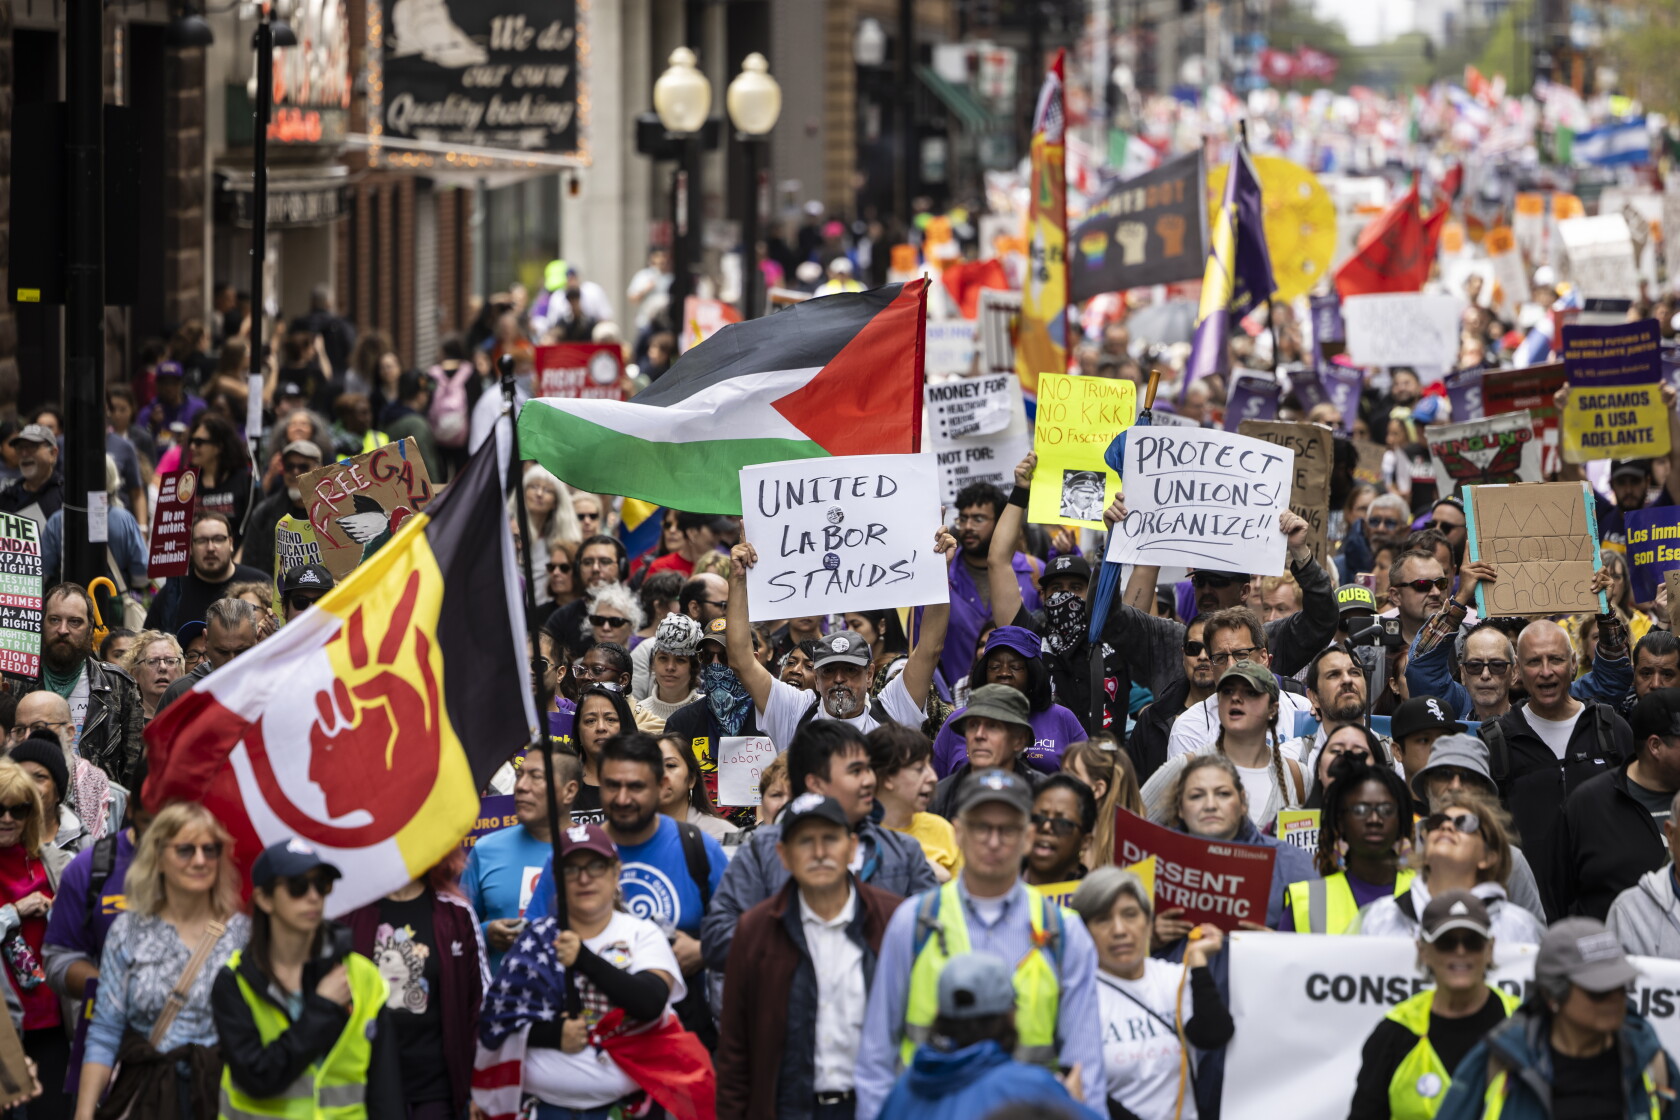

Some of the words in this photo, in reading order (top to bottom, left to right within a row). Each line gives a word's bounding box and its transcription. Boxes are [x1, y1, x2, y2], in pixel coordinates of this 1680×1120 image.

[489, 14, 535, 50] We
[537, 19, 575, 50] do
[461, 63, 511, 88] our
[512, 63, 570, 88] own
[387, 92, 486, 135] Quality
[485, 92, 575, 134] baking
[928, 382, 980, 403] MONEY
[1040, 377, 1072, 400] NO
[1079, 378, 1134, 401] TRUMP!
[1578, 390, 1650, 411] SACAMOS
[1038, 403, 1067, 423] NO
[1594, 412, 1604, 429] A
[1607, 411, 1637, 428] USA
[1036, 426, 1063, 445] NO
[1430, 427, 1532, 456] NINGUNO
[1581, 427, 1655, 448] ADELANTE
[937, 448, 962, 465] NOT
[965, 446, 995, 462] FOR:
[1134, 436, 1284, 474] PROTECT
[369, 449, 431, 512] GAZ
[758, 474, 898, 518] UNITED
[1153, 477, 1282, 510] UNIONS!
[162, 511, 173, 522] We
[173, 510, 186, 521] are
[1494, 497, 1576, 539] MY
[158, 521, 186, 535] workers,
[1122, 509, 1273, 544] ORGANIZE!!
[0, 537, 37, 555] NDA!
[164, 540, 176, 551] not
[780, 523, 888, 558] LABOR
[1627, 528, 1649, 545] Los
[151, 549, 187, 565] criminals!
[277, 541, 319, 557] EDUCATIO
[1492, 534, 1587, 565] BODY
[1633, 550, 1654, 566] son
[284, 556, 304, 568] FOR
[309, 553, 323, 567] AL
[767, 549, 918, 603] STANDS!
[1493, 563, 1562, 586] MY
[3, 583, 41, 597] ISRAEL
[1338, 587, 1372, 604] QUEER
[0, 594, 41, 608] CRIMES
[2, 618, 41, 632] RIGHTS
[19, 609, 42, 622] AND
[0, 638, 40, 654] STRIKE
[30, 633, 41, 644] TO
[0, 650, 27, 664] TION
[31, 655, 39, 666] &
[722, 752, 760, 764] Labor
[502, 815, 519, 827] ES
[1207, 844, 1231, 856] ACLU
[1233, 848, 1269, 860] Illinois
[1153, 876, 1250, 918] ATRIOTIC
